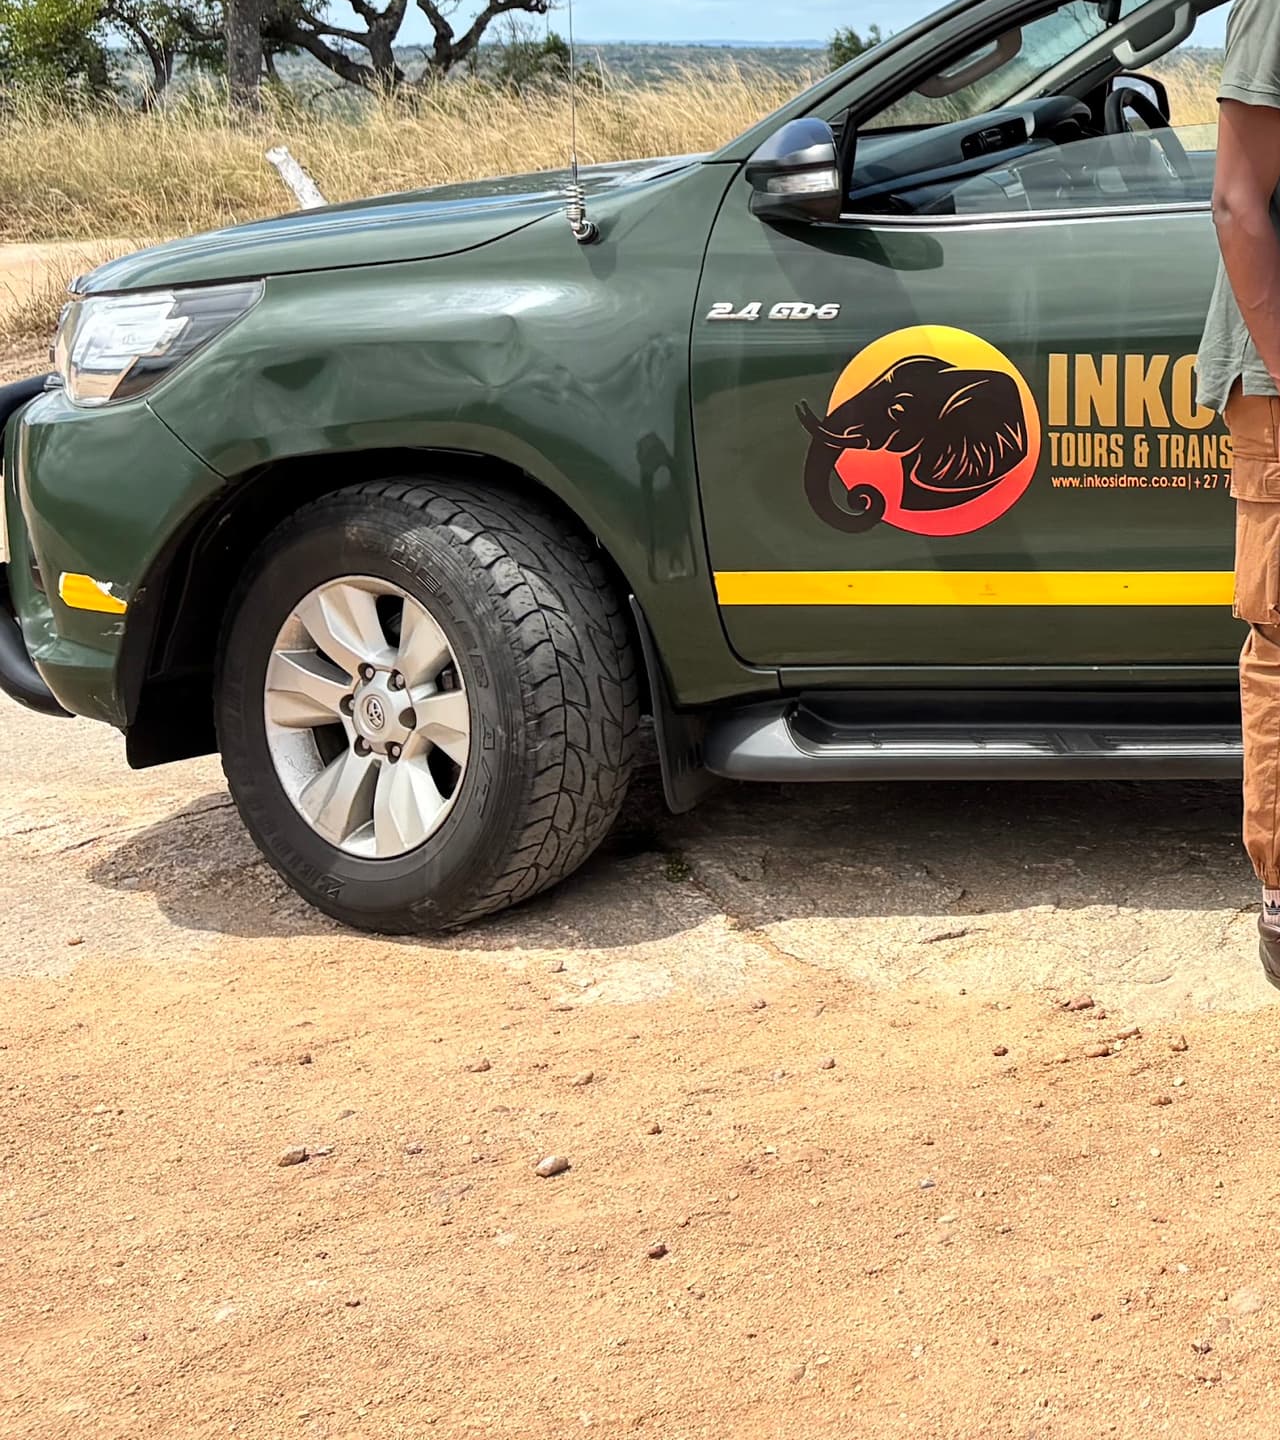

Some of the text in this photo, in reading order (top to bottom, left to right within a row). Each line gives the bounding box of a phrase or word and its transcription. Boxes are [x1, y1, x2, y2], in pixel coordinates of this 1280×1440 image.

[705, 301, 762, 320] 2.4
[1047, 353, 1216, 430] INKO
[1048, 432, 1233, 469] TOURS & TRANS
[1223, 473, 1231, 489] 7
